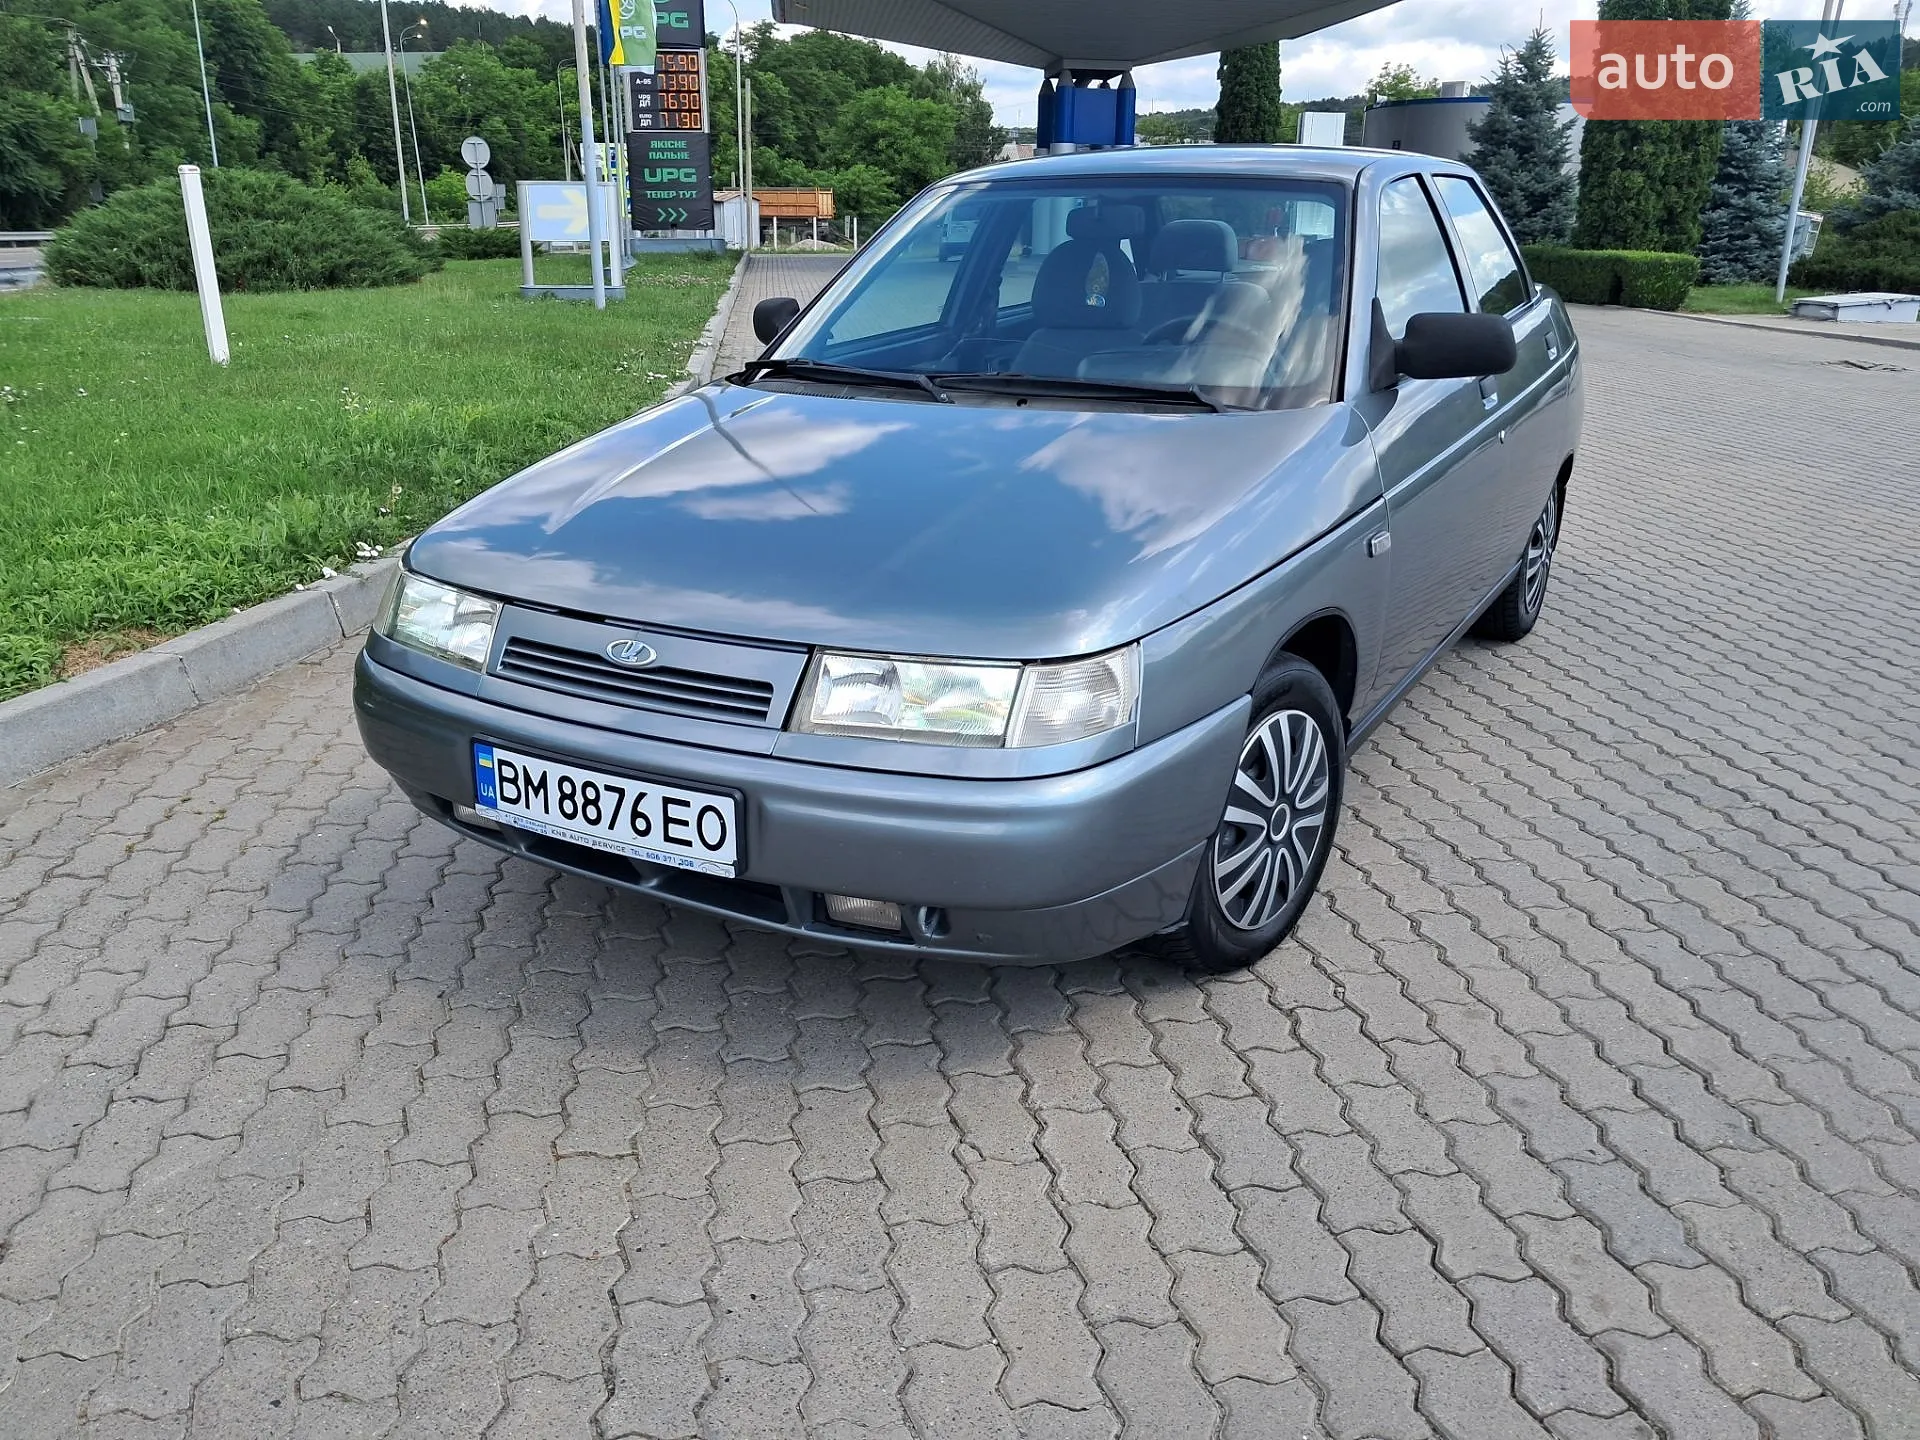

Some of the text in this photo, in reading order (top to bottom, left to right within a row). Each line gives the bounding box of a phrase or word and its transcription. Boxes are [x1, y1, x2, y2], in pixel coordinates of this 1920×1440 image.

[656, 11, 689, 28] PG
[619, 26, 648, 39] PG
[650, 140, 688, 149] ЯКІСНЕ
[648, 151, 690, 160] ПАЛЬНЕ
[643, 167, 698, 183] UPG
[645, 190, 698, 199] ТЕПЕР ТУТ
[480, 782, 495, 799] UA
[497, 758, 727, 852] BM 8876 EO
[569, 832, 589, 844] AUTO
